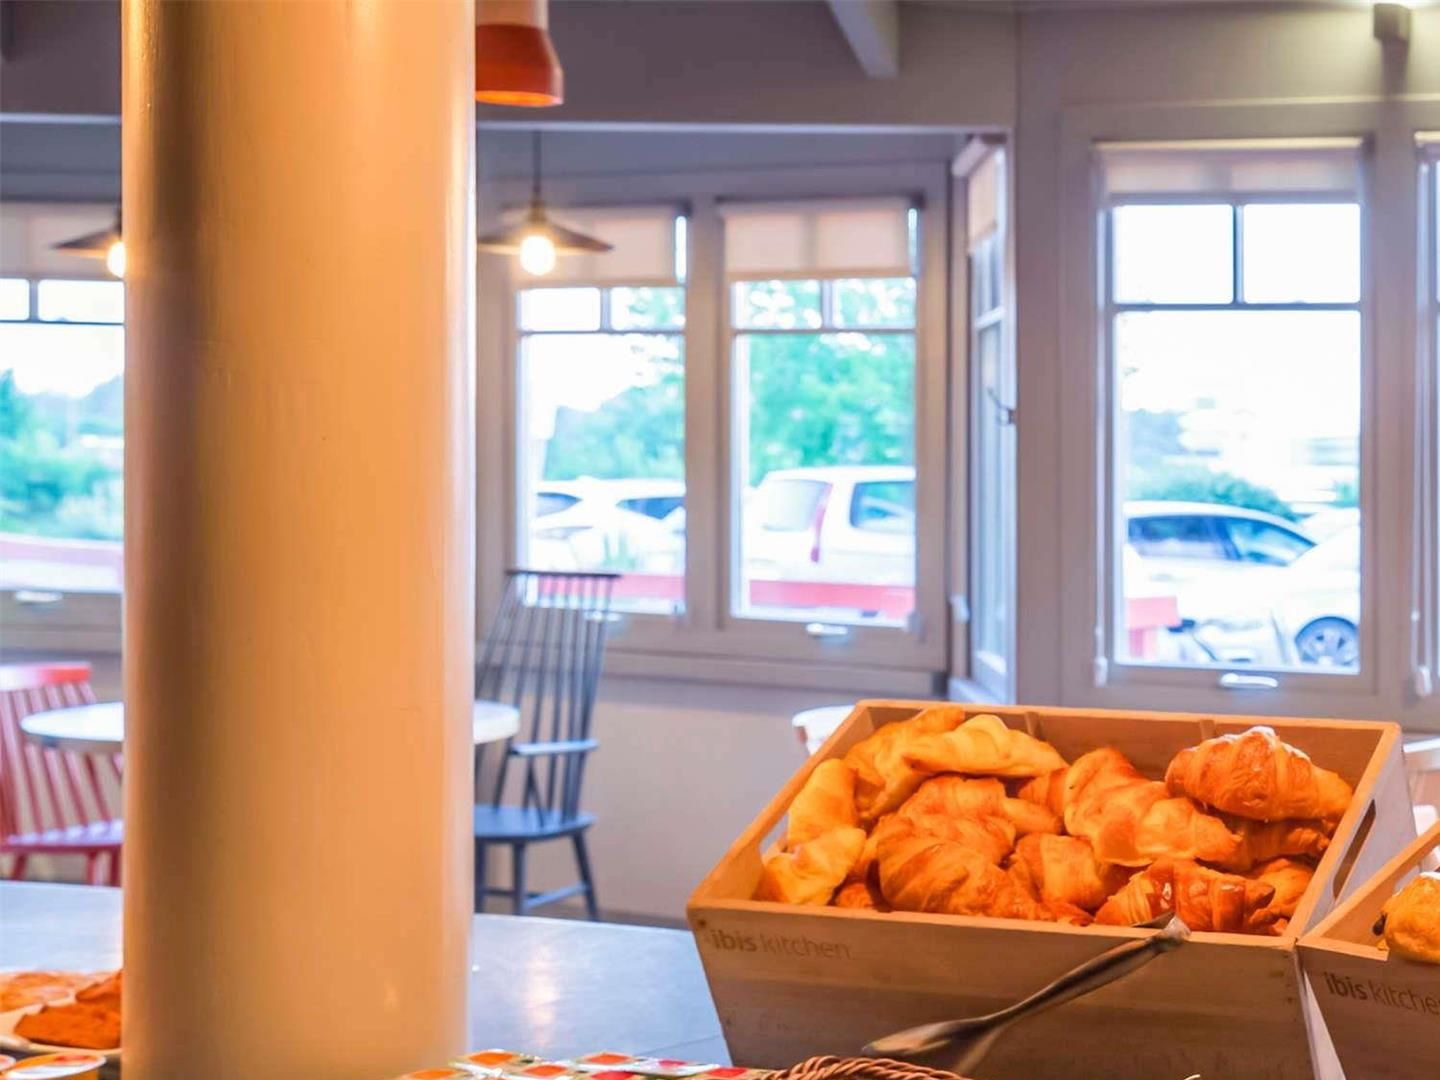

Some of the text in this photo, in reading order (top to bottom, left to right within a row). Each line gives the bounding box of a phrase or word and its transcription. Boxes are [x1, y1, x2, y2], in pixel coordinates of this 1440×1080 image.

[709, 928, 851, 959] ibis kitchen
[1324, 971, 1368, 1001] ibis
